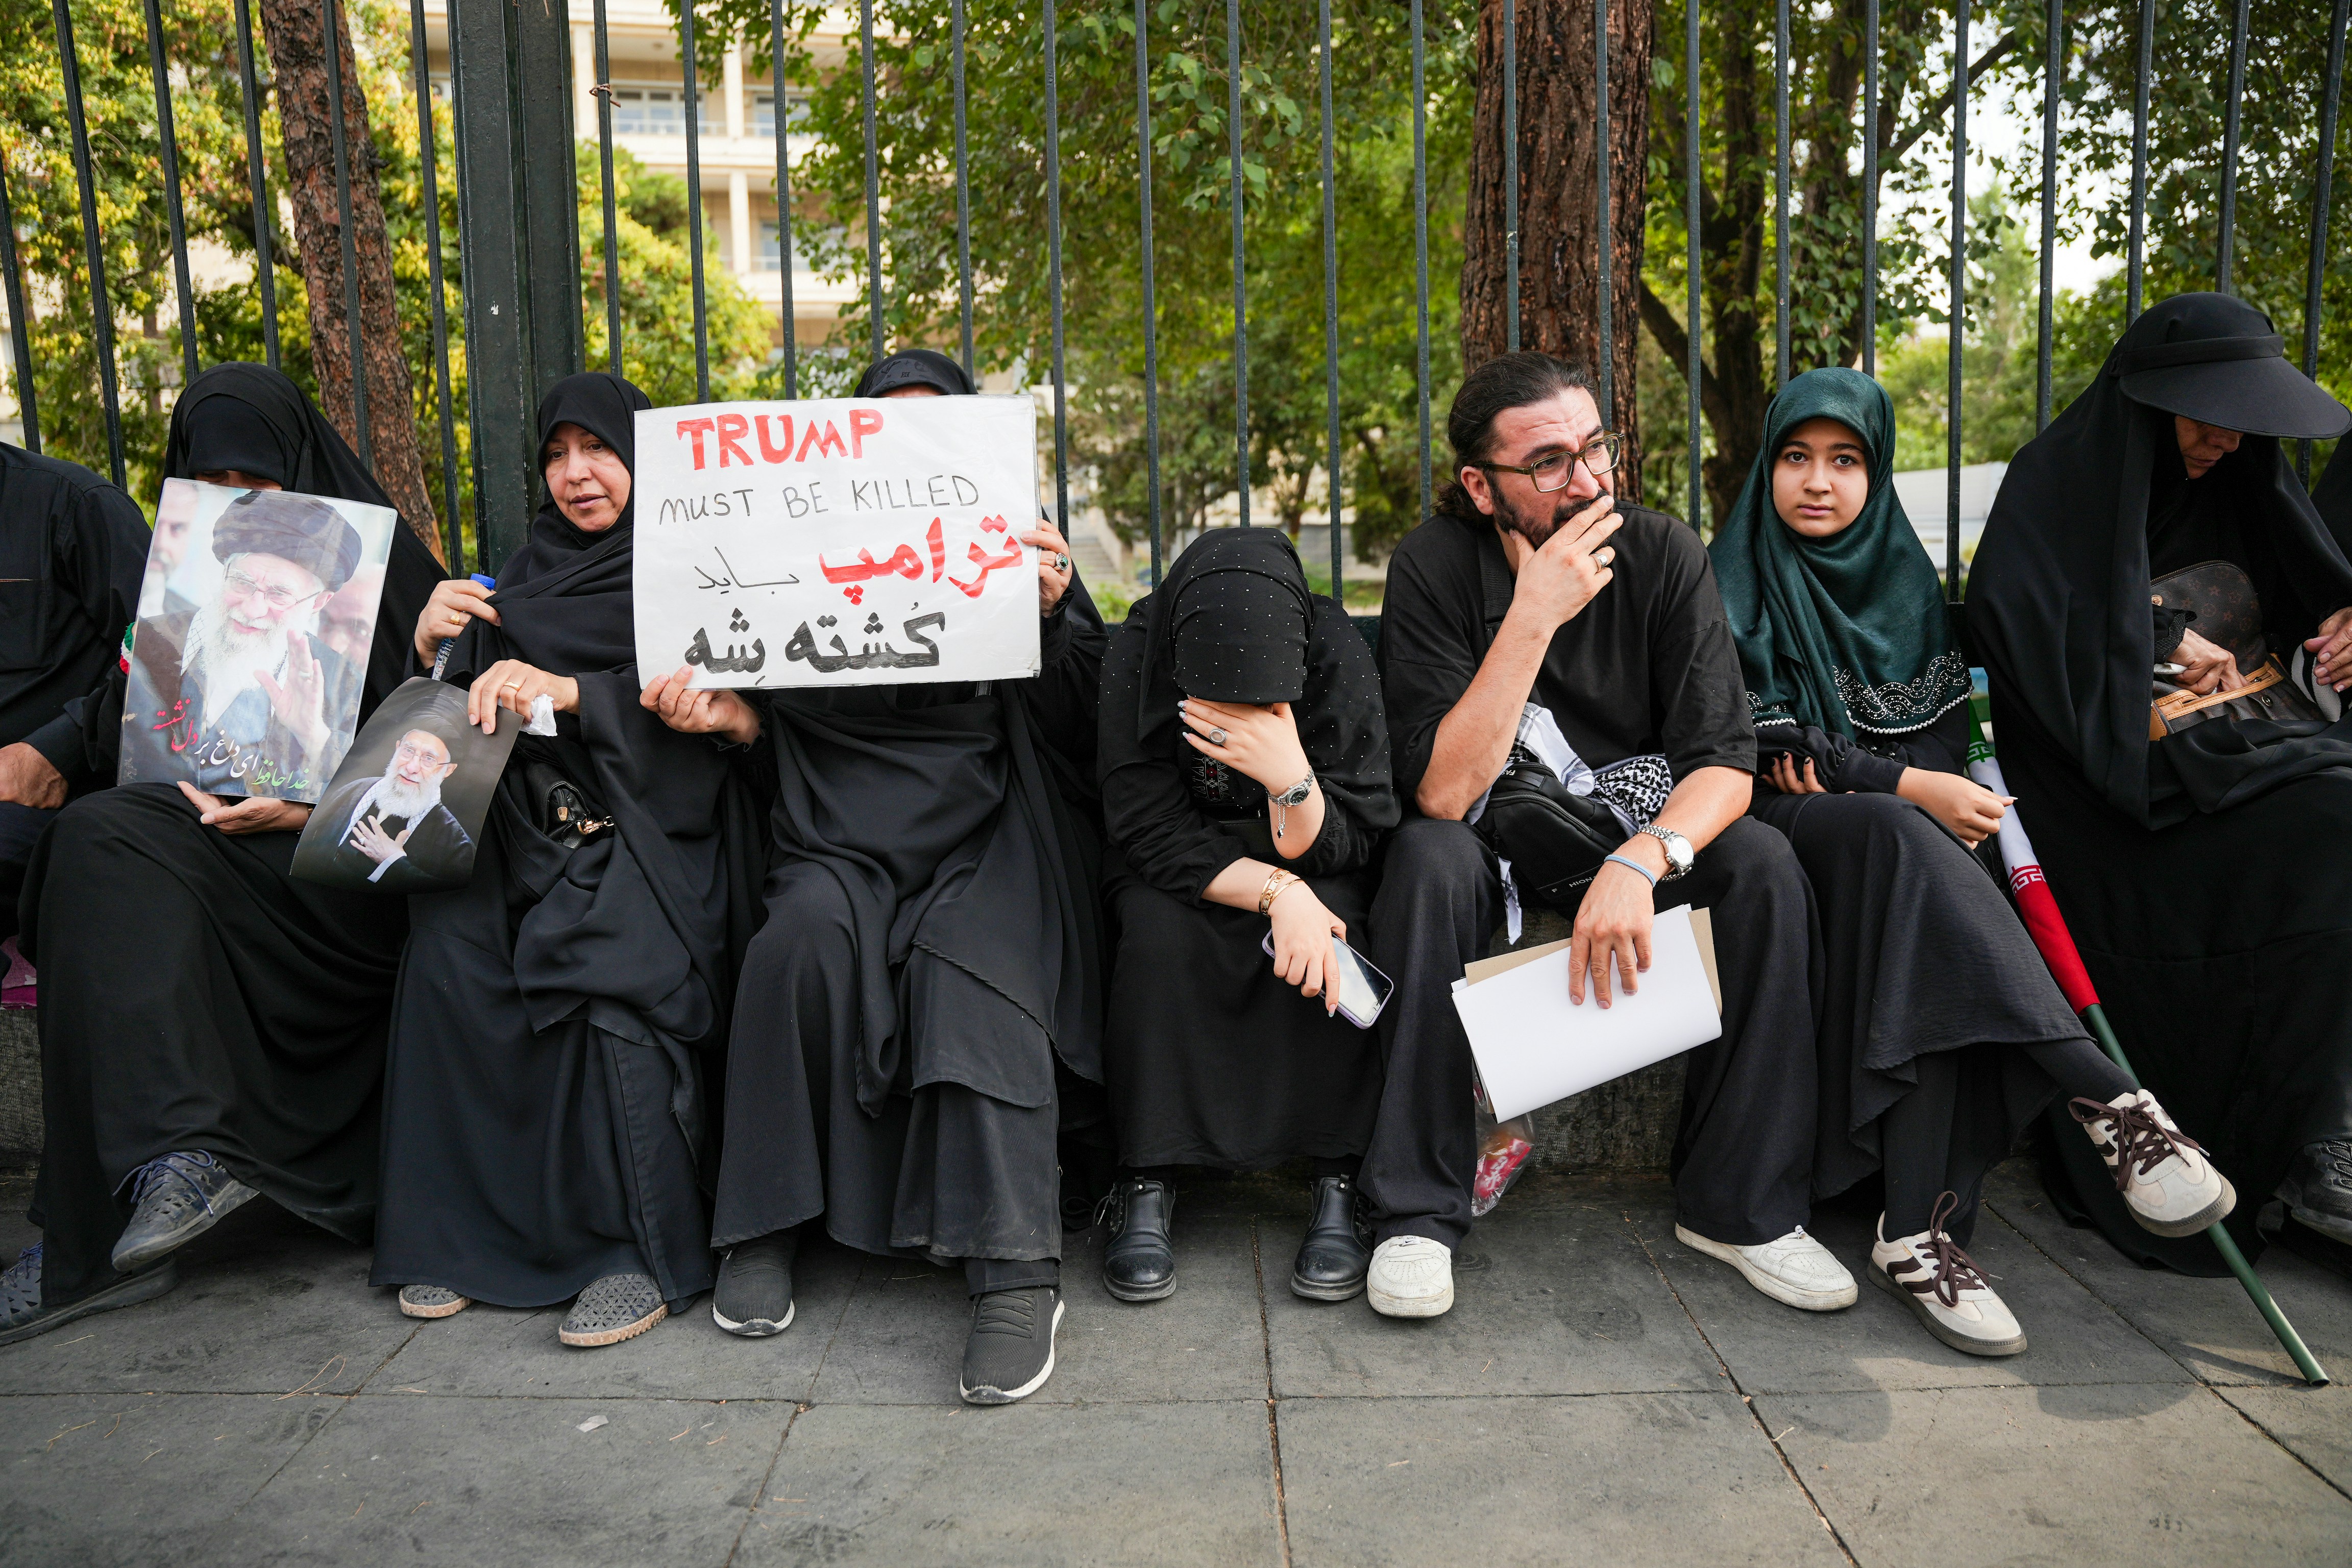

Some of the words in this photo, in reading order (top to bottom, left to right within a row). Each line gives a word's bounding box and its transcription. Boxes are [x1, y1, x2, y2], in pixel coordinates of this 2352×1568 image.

[676, 409, 884, 471] TRUMP
[659, 488, 754, 525] MUST
[782, 481, 829, 519] BE
[851, 475, 979, 511] KILLED
[694, 546, 800, 595] باید
[819, 513, 1023, 606] ترامپ
[152, 698, 191, 730] نشسته
[171, 718, 199, 752] دل
[210, 729, 241, 765] داغ
[193, 741, 210, 765] بر
[230, 754, 260, 778] ای
[251, 758, 310, 790] خداحافظ
